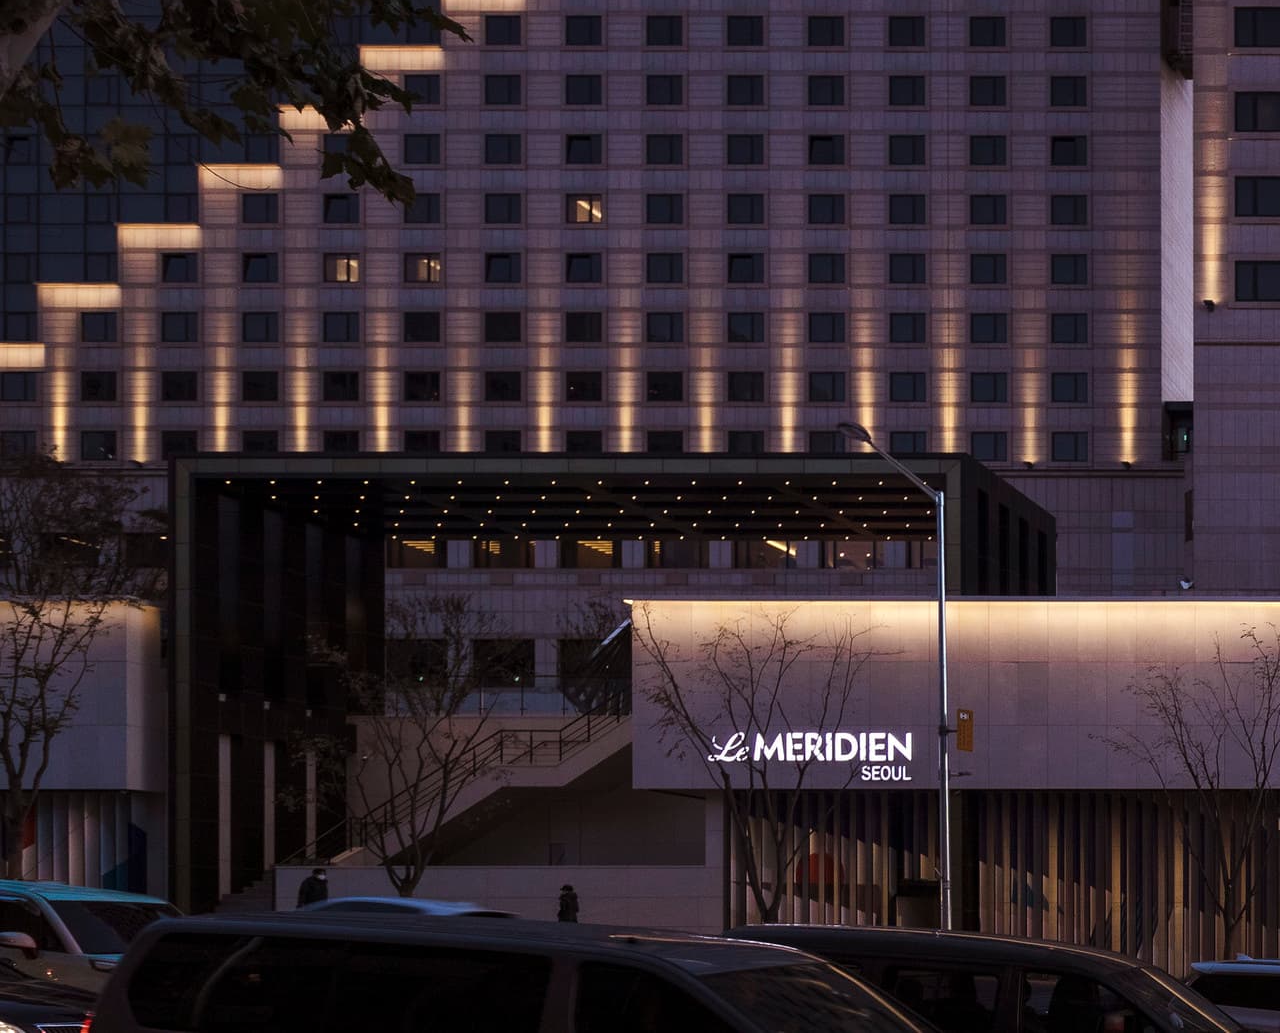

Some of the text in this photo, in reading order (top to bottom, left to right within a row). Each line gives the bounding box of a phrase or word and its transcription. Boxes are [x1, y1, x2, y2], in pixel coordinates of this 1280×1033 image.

[708, 732, 913, 762] Le MERIDIEN
[861, 765, 912, 781] SEOUL
